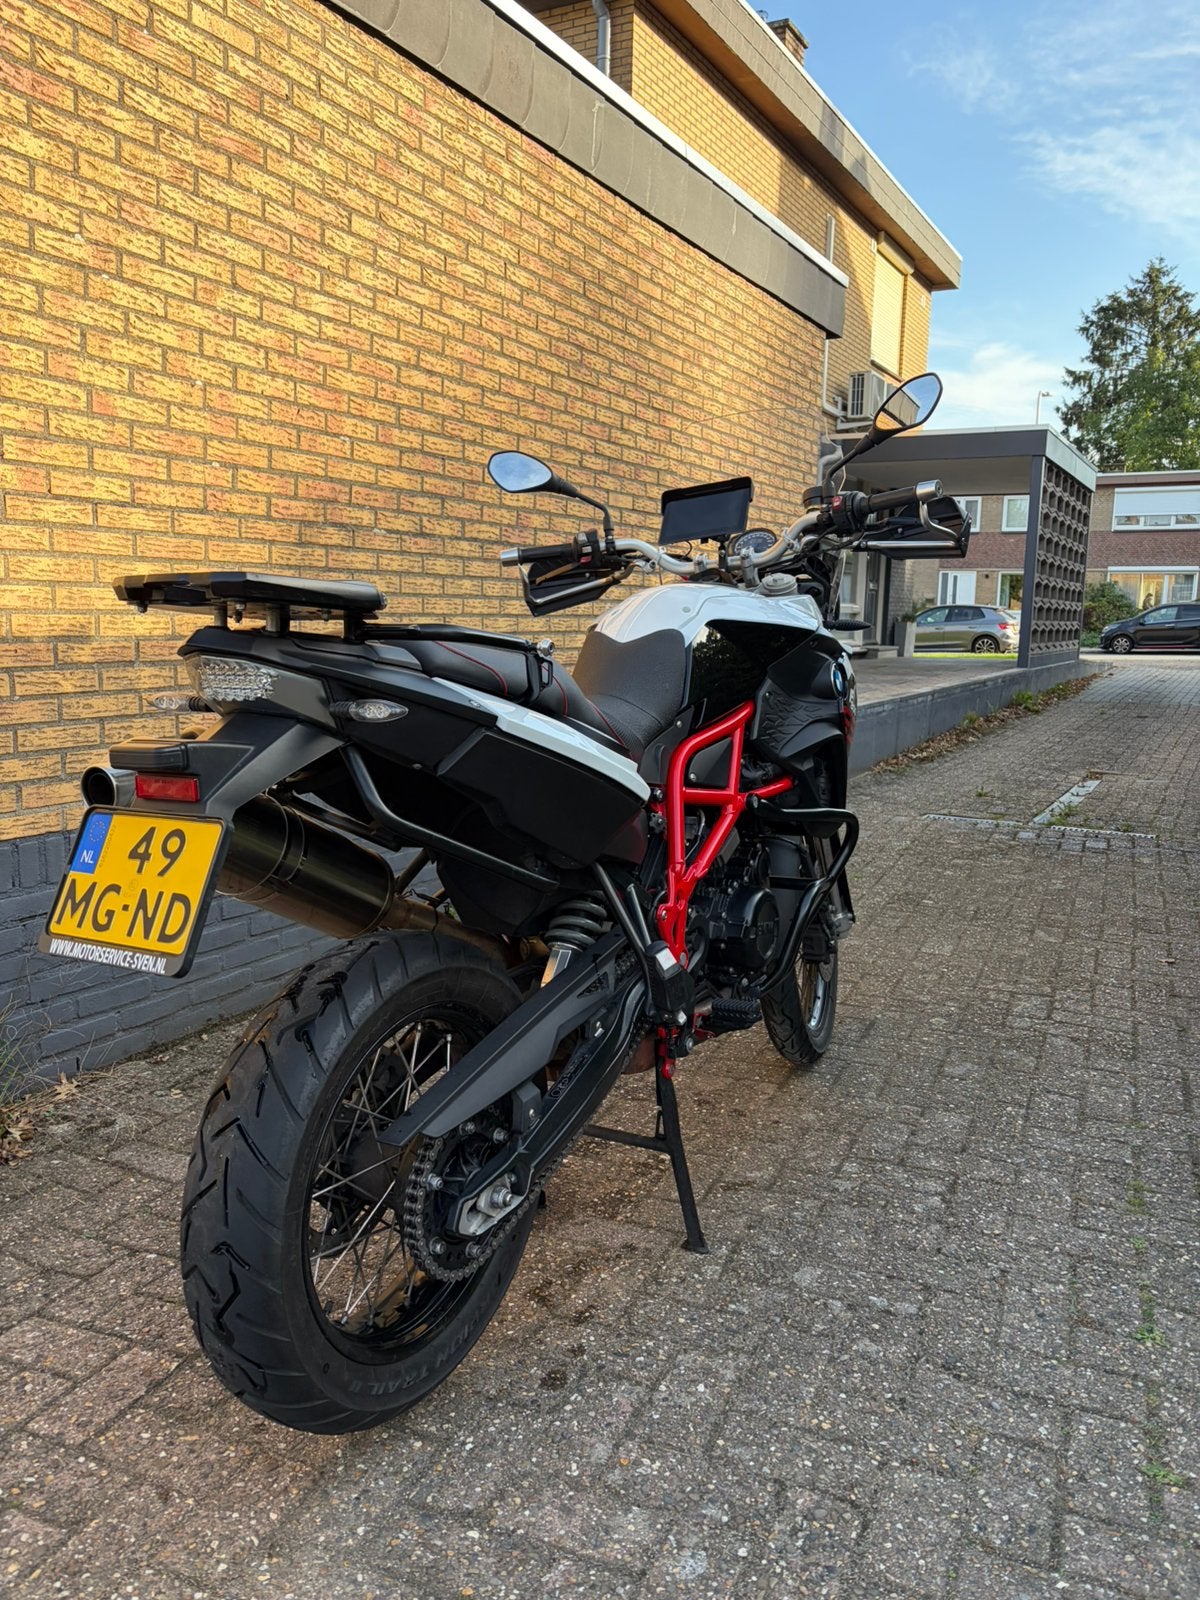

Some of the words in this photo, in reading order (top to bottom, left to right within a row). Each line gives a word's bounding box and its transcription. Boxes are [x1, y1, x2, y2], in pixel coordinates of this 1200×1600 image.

[80, 850, 94, 864] NL
[128, 826, 186, 877] 49
[49, 938, 167, 974] WWW.MOTORSERVICE-SVEN.NL
